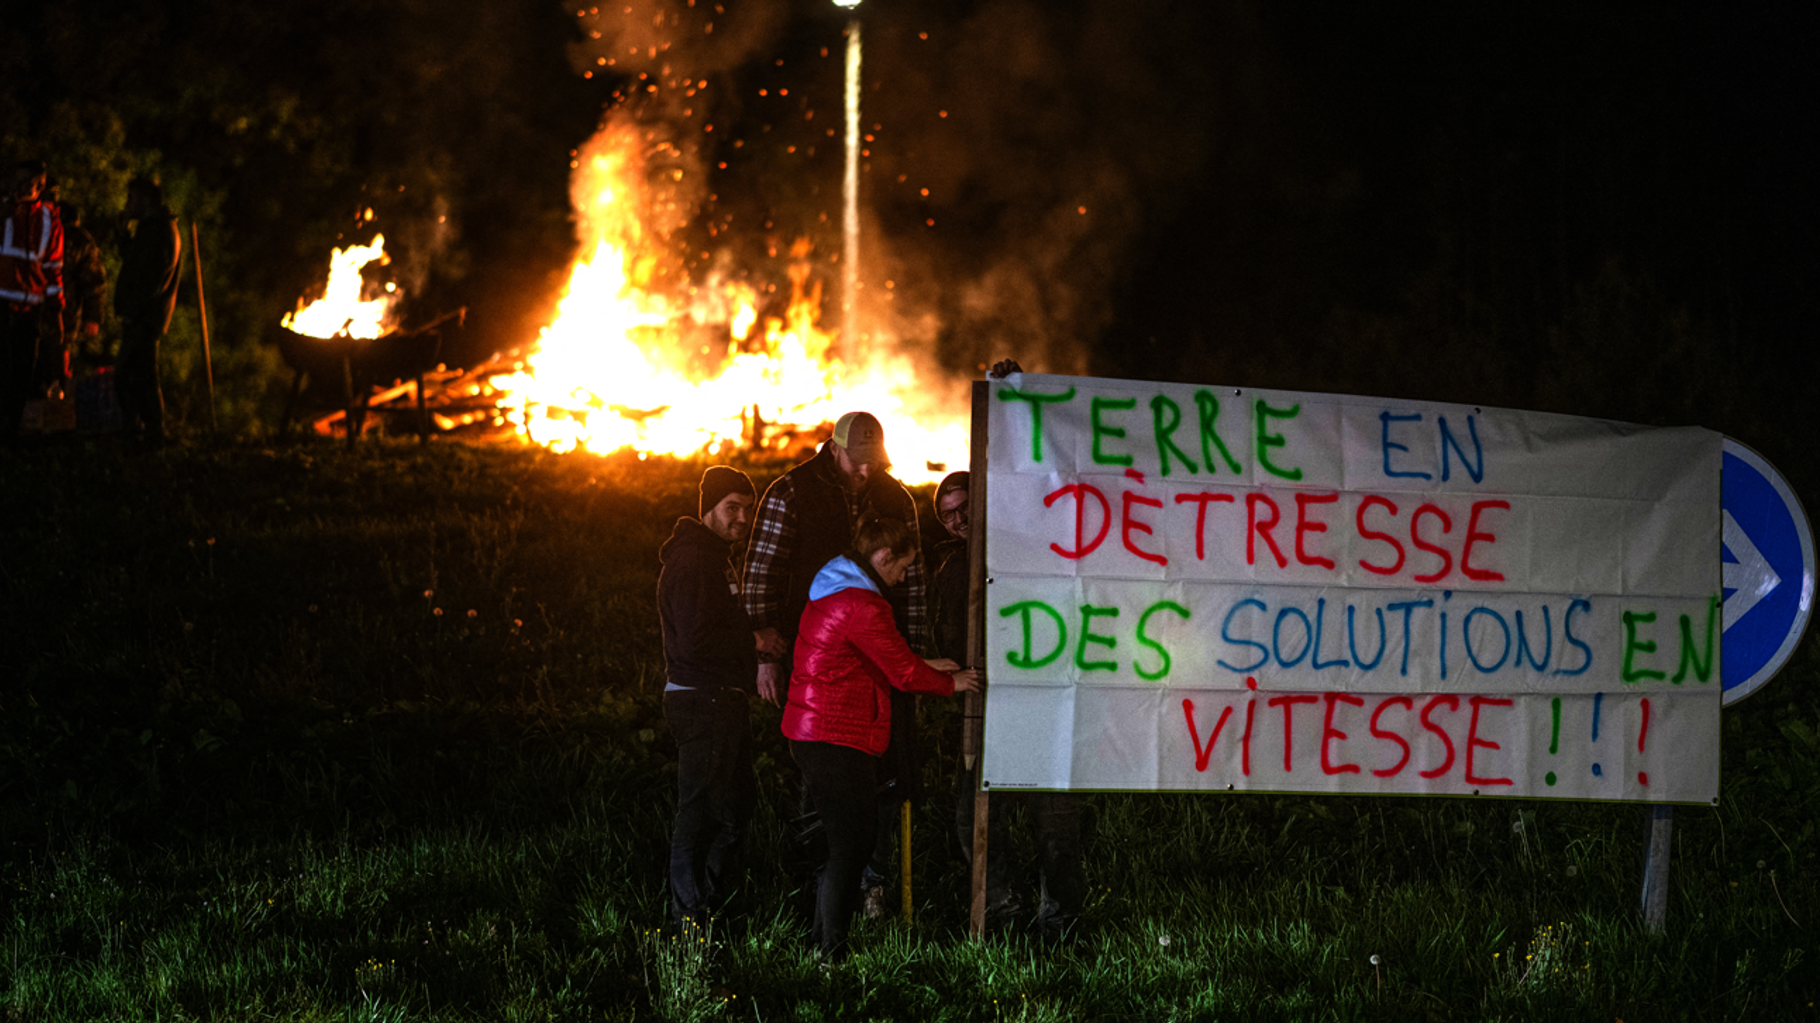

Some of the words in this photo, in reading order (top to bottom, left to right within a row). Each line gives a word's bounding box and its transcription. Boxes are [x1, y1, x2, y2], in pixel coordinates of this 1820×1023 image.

[997, 386, 1303, 481] TERRE
[1379, 411, 1484, 484] EN
[999, 600, 1191, 681] DES
[1621, 596, 1718, 684] EN
